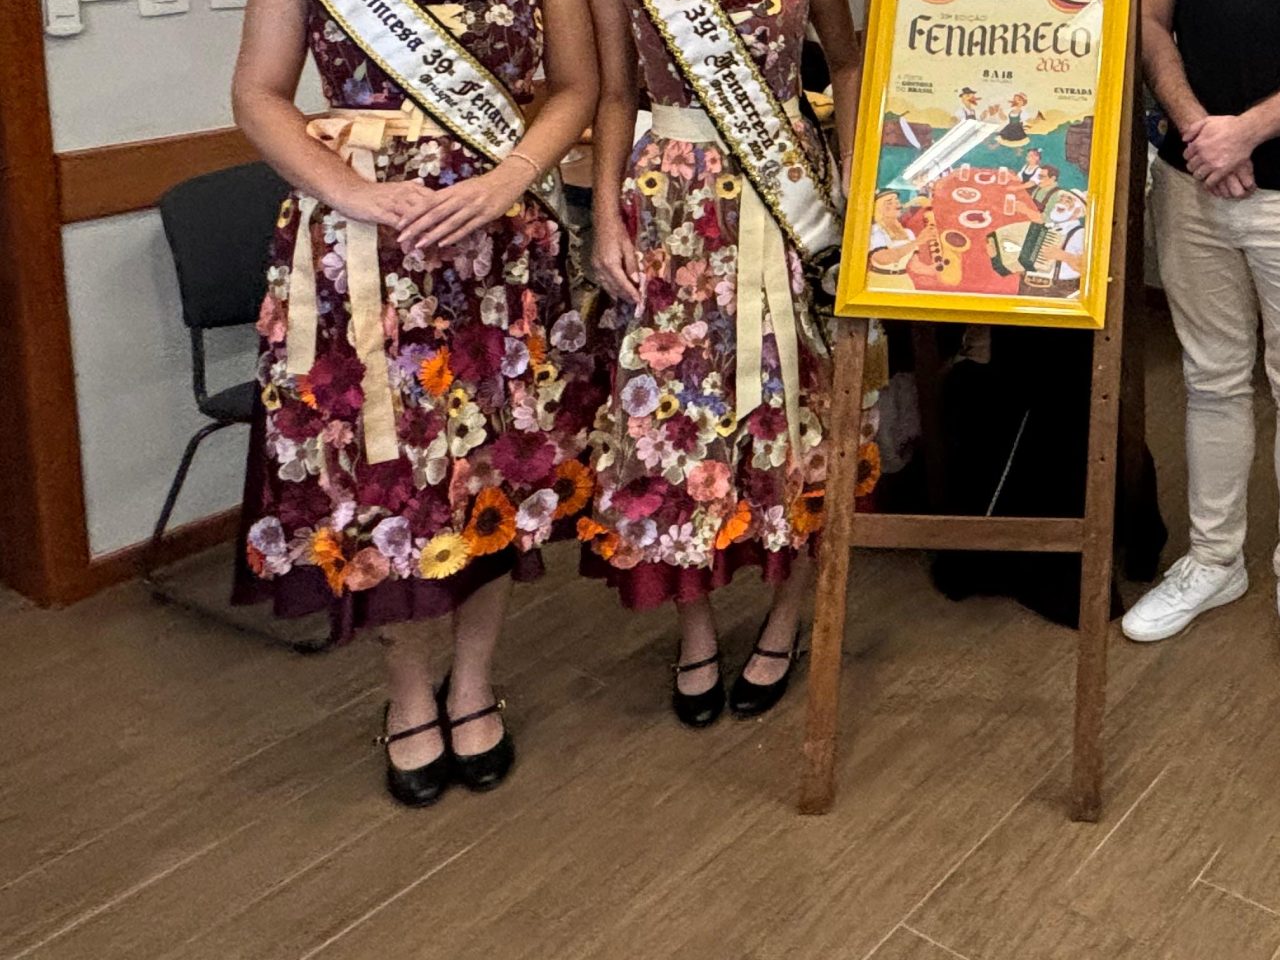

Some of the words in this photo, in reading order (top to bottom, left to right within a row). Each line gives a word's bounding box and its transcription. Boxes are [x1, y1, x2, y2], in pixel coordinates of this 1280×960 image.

[1036, 57, 1071, 73] 2026
[982, 69, 990, 78] 8
[991, 70, 999, 79] A
[1001, 71, 1013, 79] 18
[1054, 87, 1093, 95] ENTRADA
[704, 50, 775, 150] Fenarreco
[460, 111, 481, 126] SC
[735, 120, 751, 134] SC
